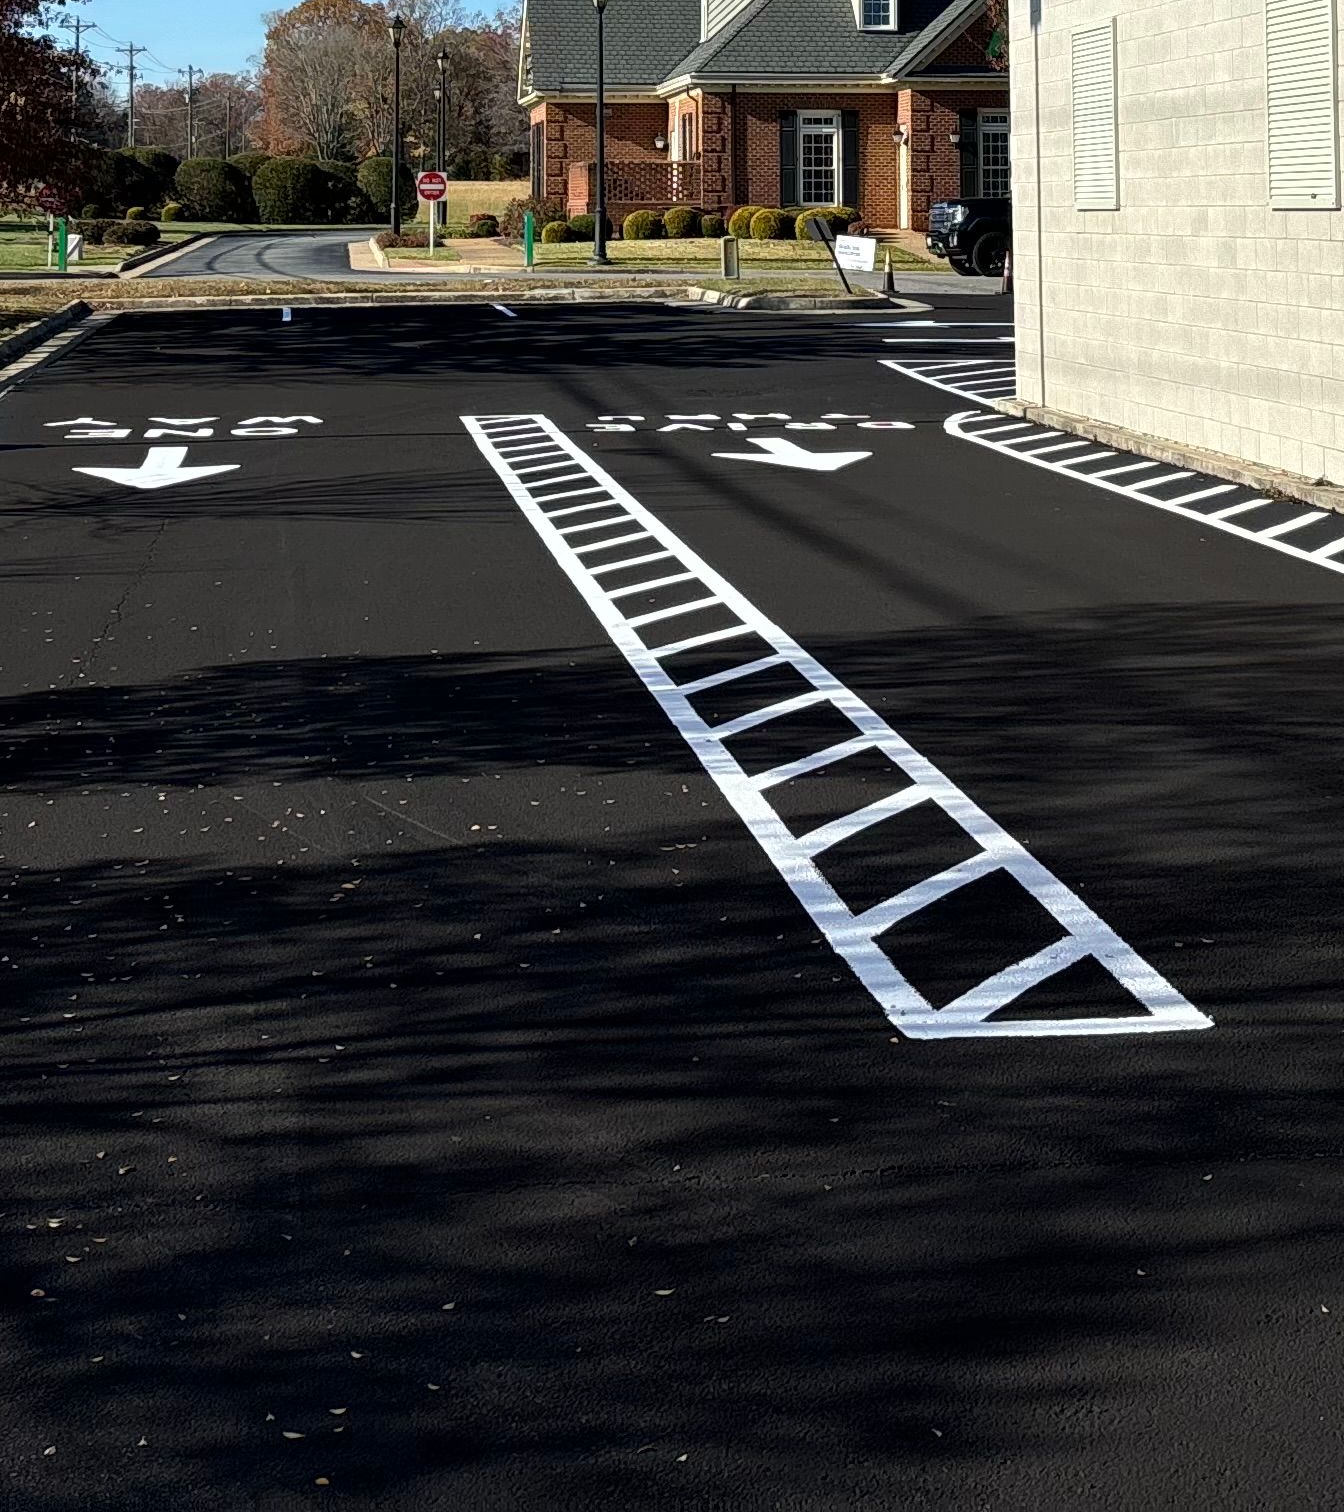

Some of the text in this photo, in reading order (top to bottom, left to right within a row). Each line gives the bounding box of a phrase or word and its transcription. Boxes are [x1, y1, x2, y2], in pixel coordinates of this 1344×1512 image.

[42, 415, 324, 426] WAY
[63, 426, 299, 438] ONE
[585, 421, 916, 432] DRIVE
